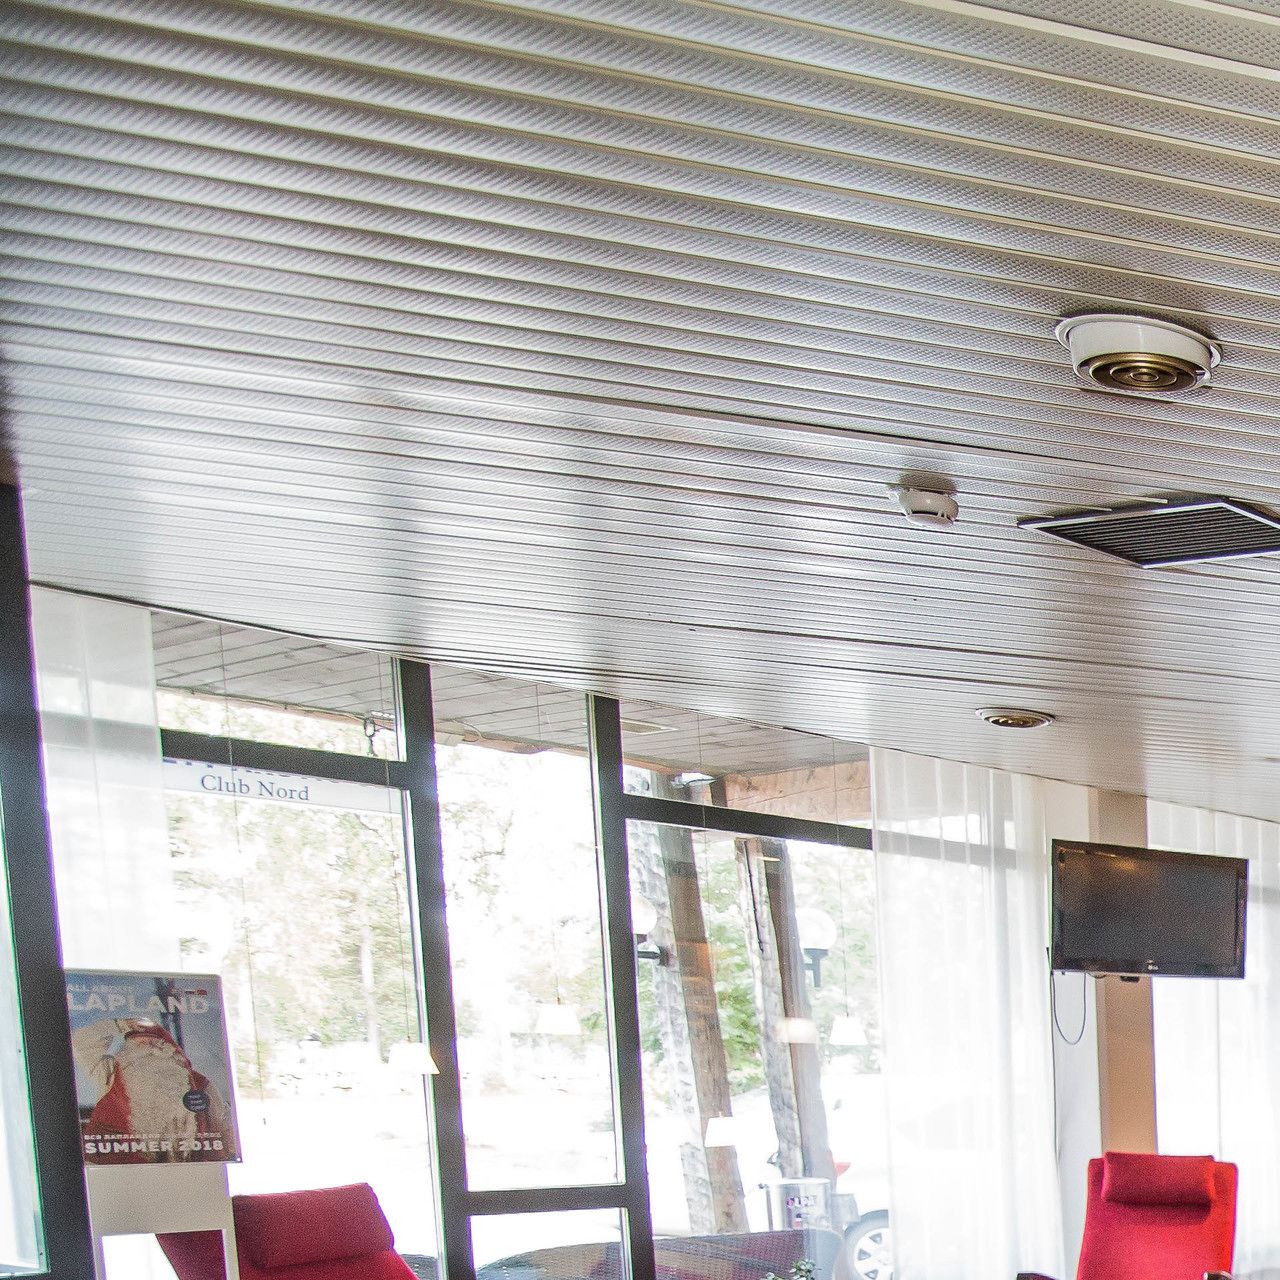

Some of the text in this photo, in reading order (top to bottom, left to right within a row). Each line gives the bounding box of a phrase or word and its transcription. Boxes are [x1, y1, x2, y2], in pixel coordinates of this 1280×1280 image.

[200, 774, 251, 794] Club
[257, 780, 310, 801] Nord
[66, 992, 209, 1014] LAPLAND
[84, 1139, 224, 1154] SUMMER 2018
